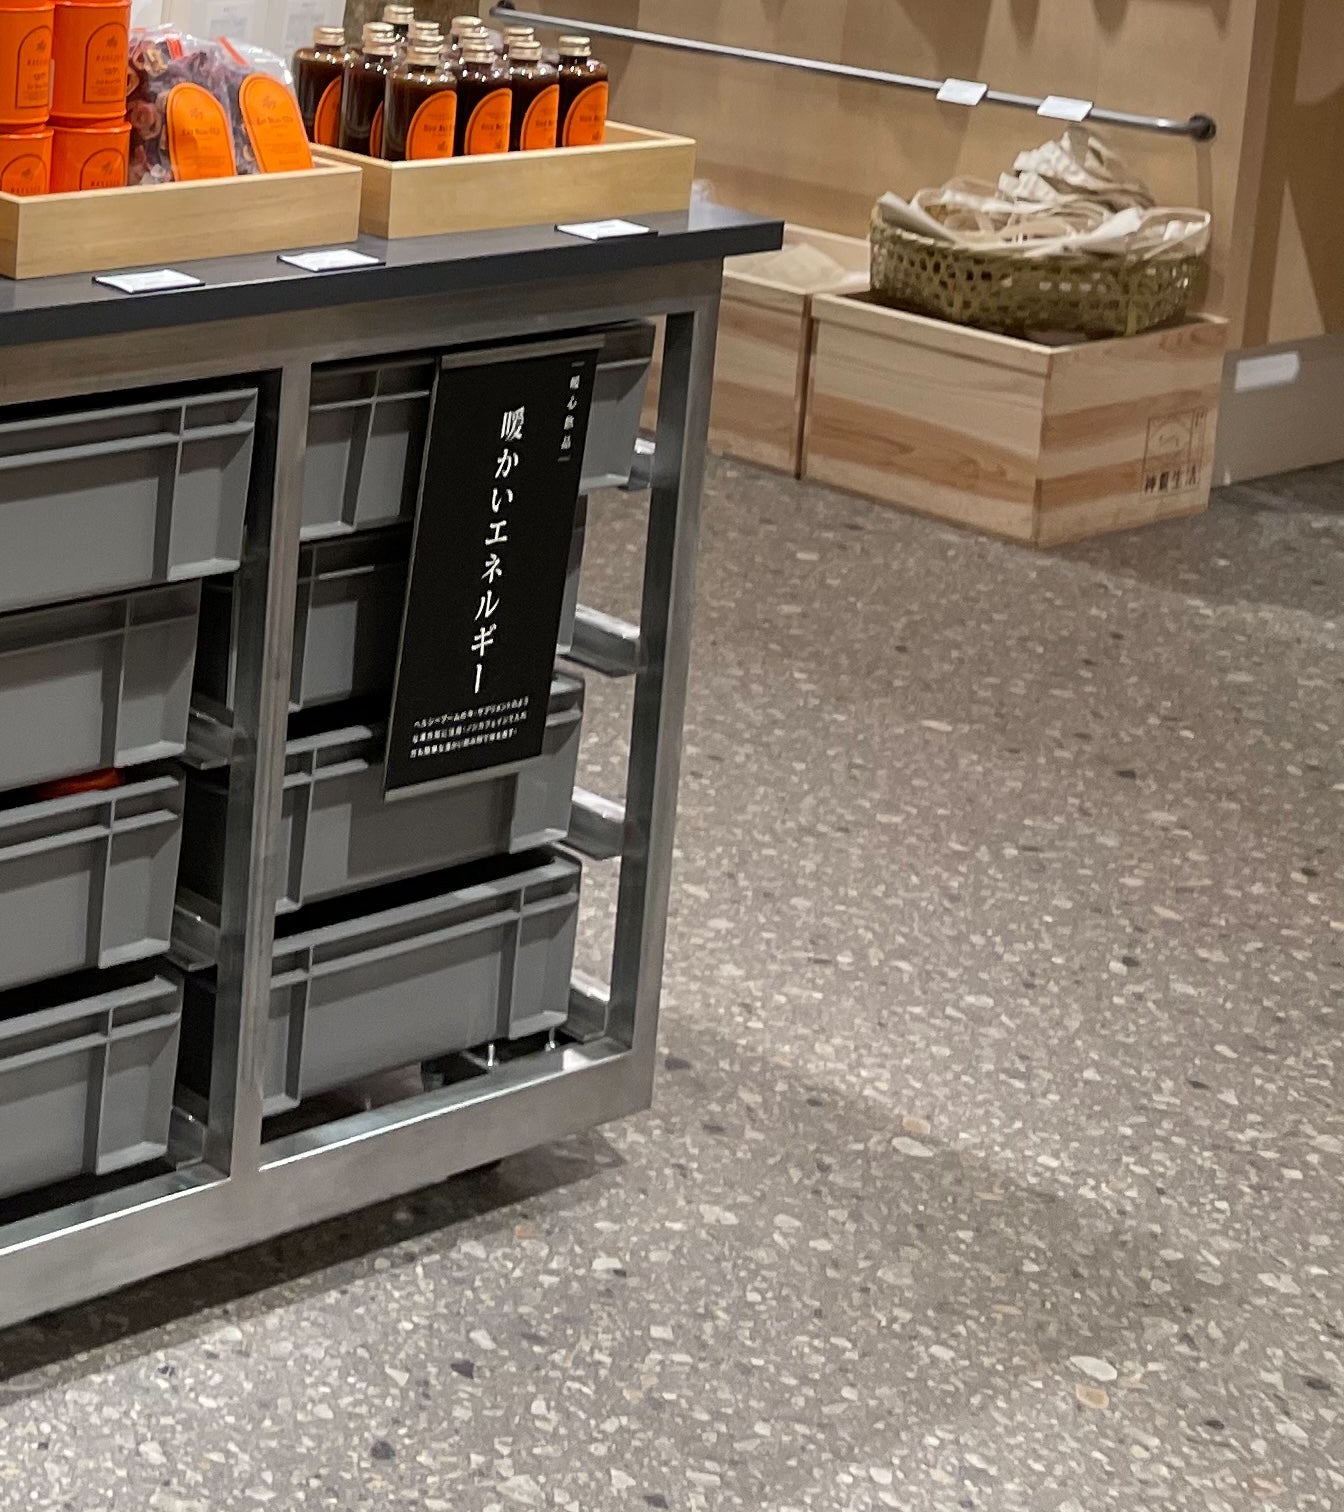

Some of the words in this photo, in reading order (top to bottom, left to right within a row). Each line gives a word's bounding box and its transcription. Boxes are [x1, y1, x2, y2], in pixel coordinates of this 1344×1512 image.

[470, 405, 526, 695] 暖かいエネルギー
